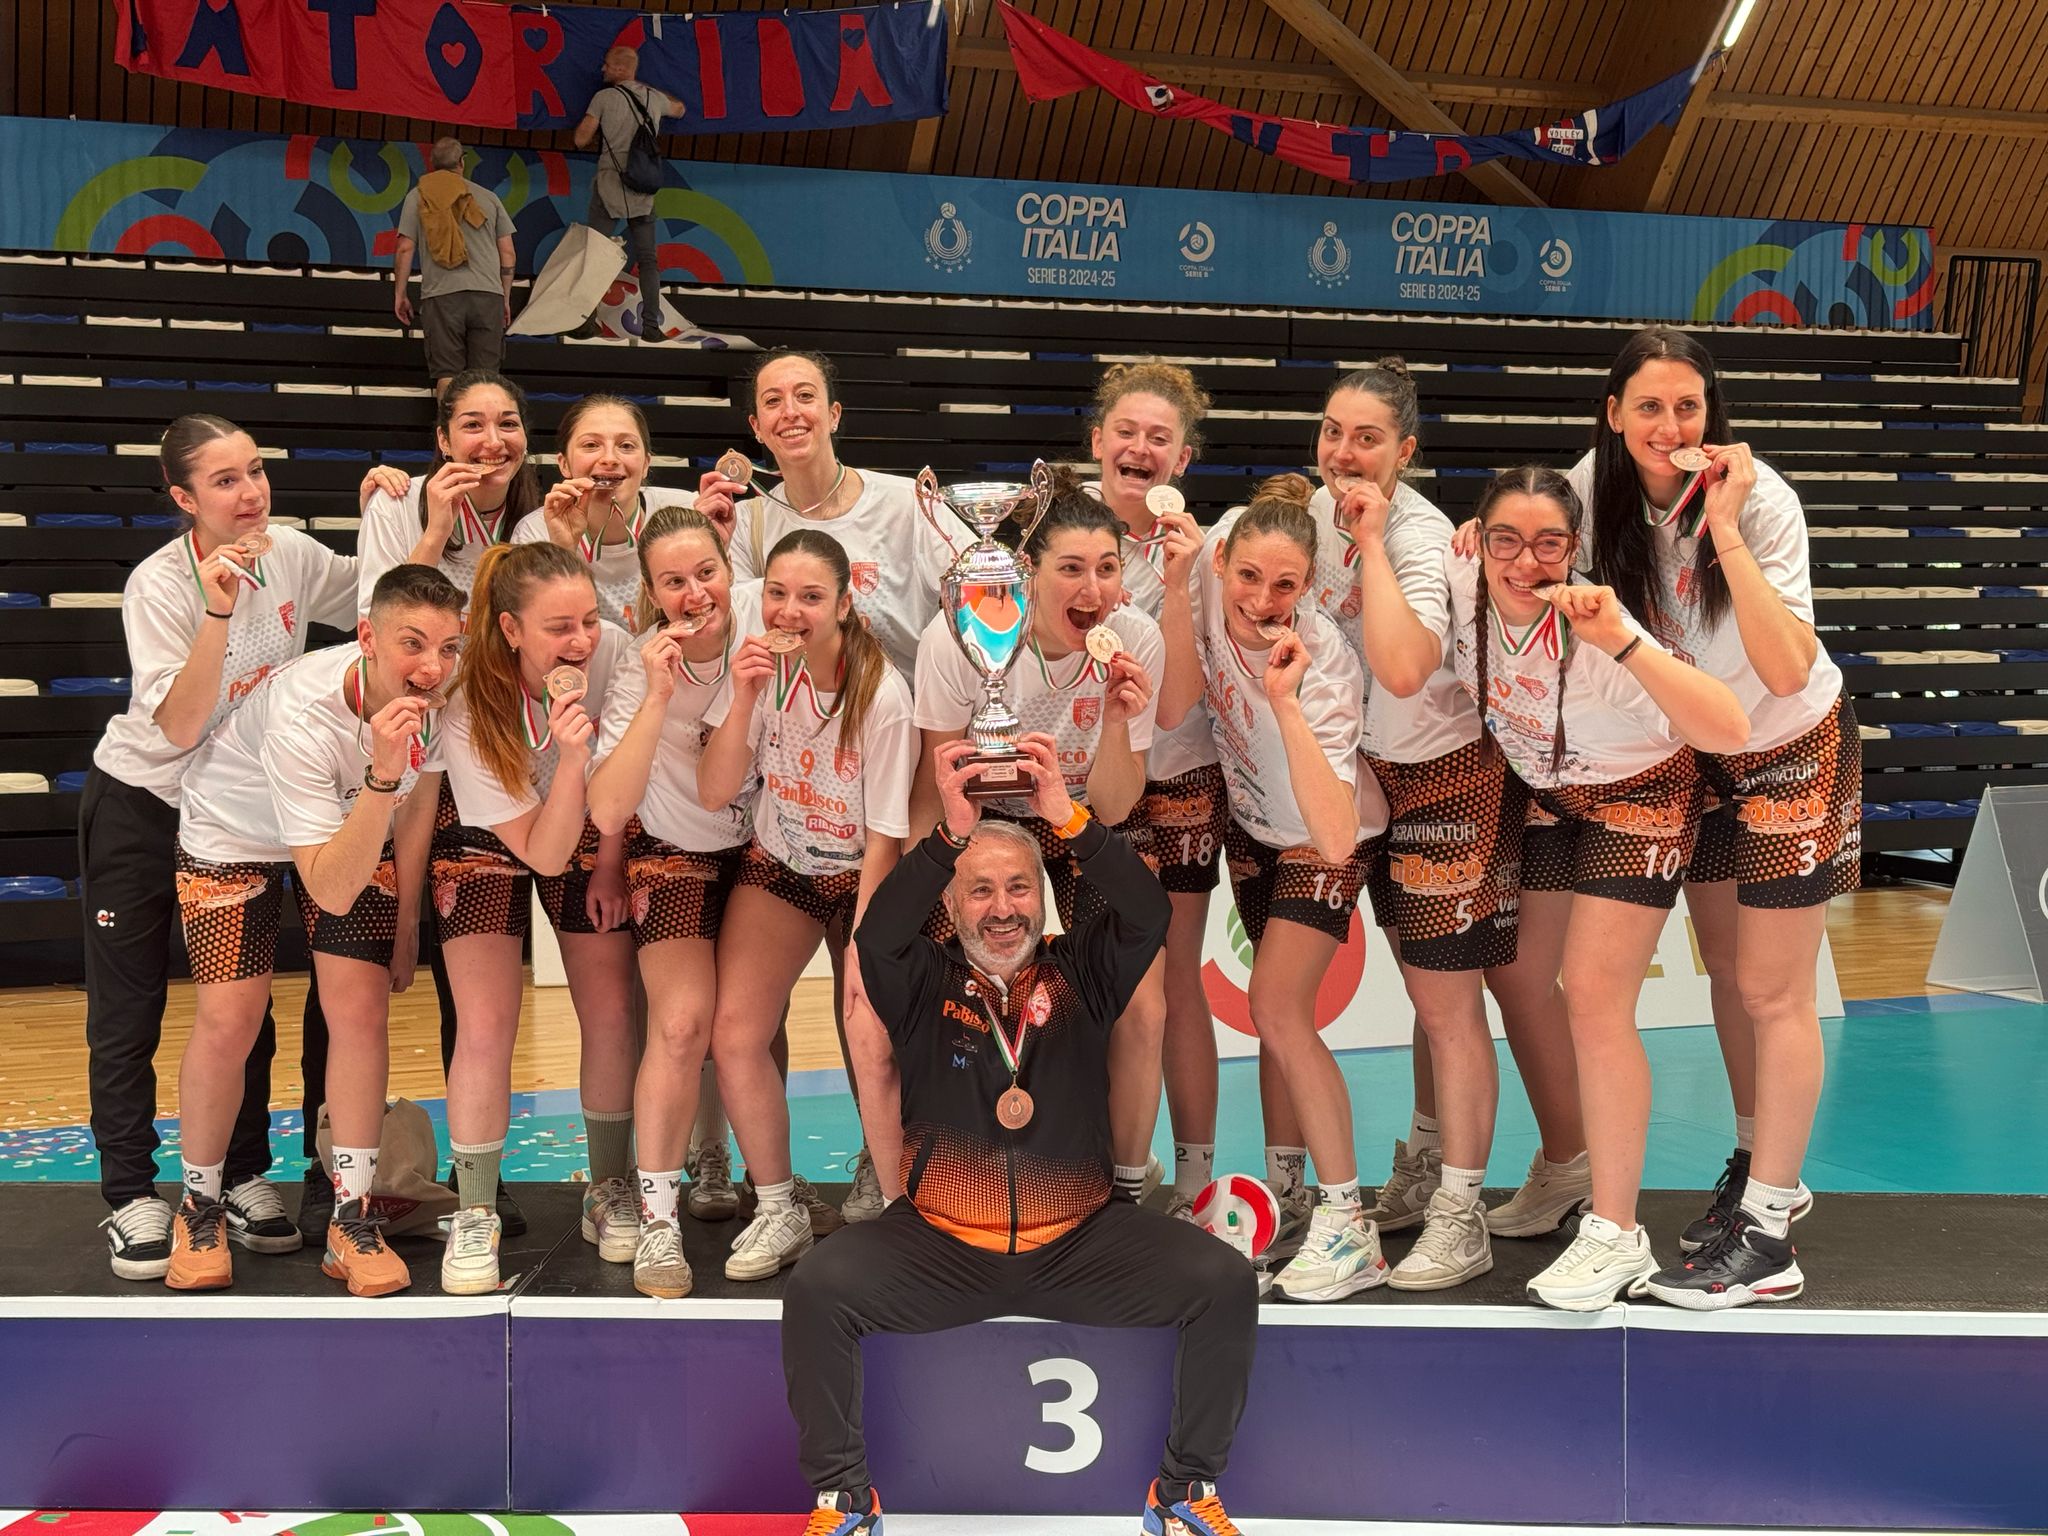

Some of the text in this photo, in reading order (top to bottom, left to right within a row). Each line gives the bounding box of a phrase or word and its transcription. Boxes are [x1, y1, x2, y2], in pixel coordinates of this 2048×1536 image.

[1549, 128, 1581, 139] VOLLEY
[1016, 192, 1128, 228] COPPA
[1021, 228, 1121, 262] ITALIA
[1391, 211, 1492, 246] COPPA
[1028, 267, 1116, 287] SERIE B 2024-25
[1394, 245, 1485, 278] ITALIA
[1400, 283, 1481, 301] SERIE B 2024-25
[800, 749, 815, 778] 9
[767, 771, 848, 815] PanBiscò
[1736, 789, 1826, 824] Biscò
[1178, 832, 1214, 867] 18
[1644, 843, 1681, 882] 10
[1797, 839, 1818, 877] 3
[1313, 872, 1344, 910] 16
[1455, 898, 1474, 935] 5
[642, 1178, 657, 1194] 2
[1025, 1357, 1103, 1474] 3
